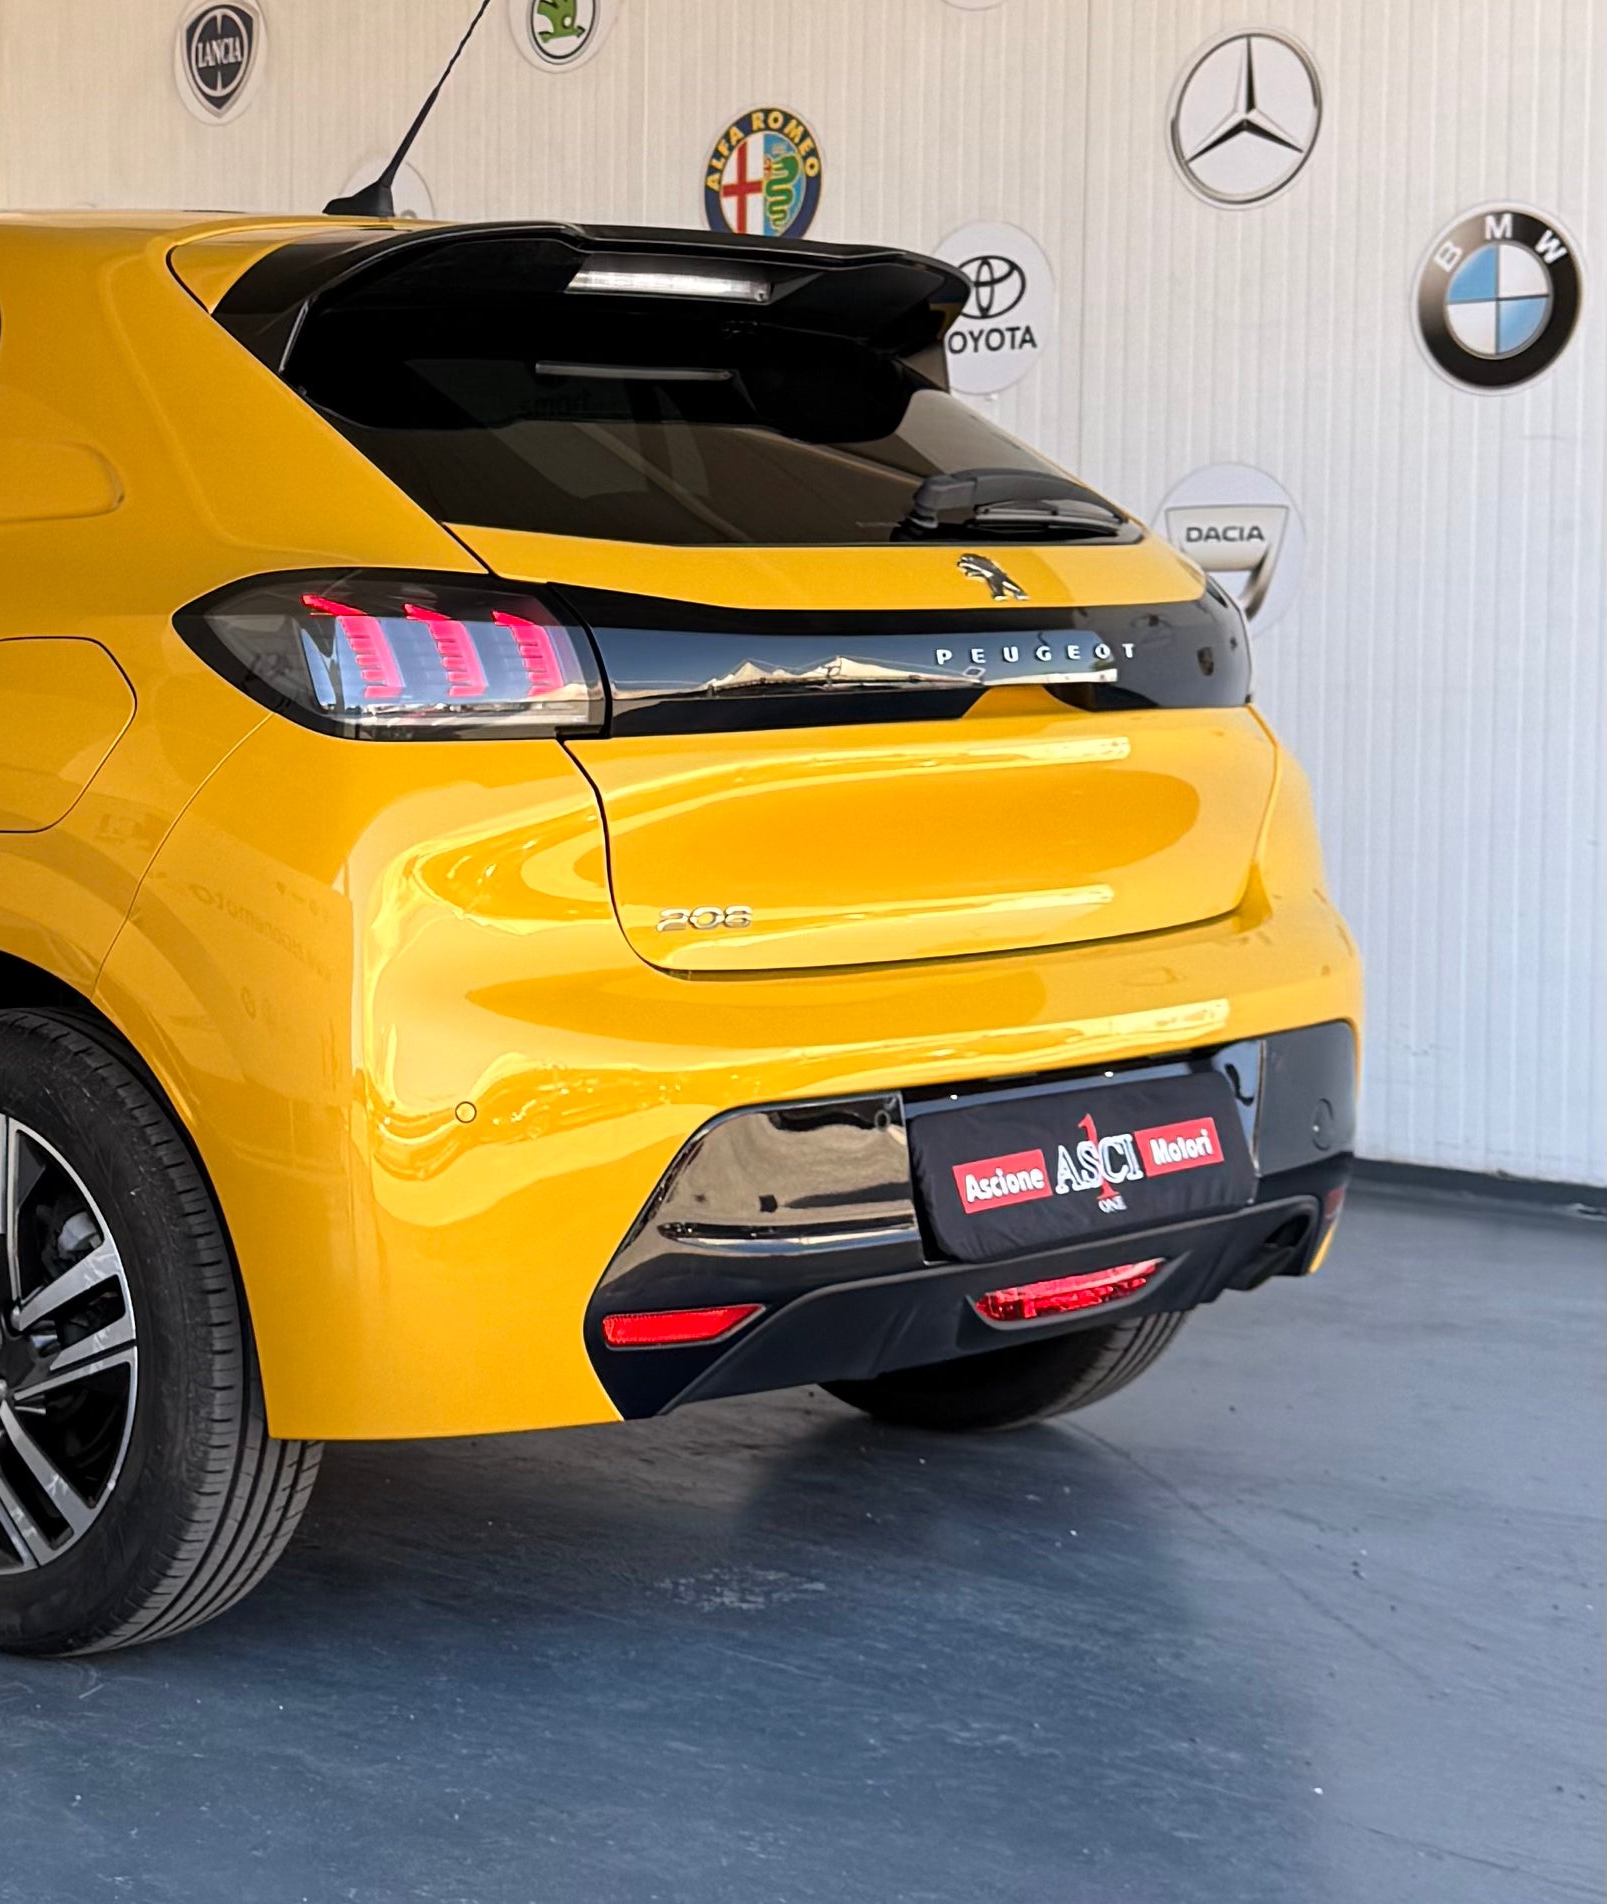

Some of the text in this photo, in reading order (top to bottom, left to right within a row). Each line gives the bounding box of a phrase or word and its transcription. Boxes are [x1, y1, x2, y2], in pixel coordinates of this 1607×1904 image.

[197, 36, 243, 68] LANCIA
[706, 110, 820, 192] ALFA ROMEO
[1433, 213, 1568, 273] BMW
[948, 325, 1037, 354] OYOTA
[1186, 525, 1266, 543] DACIA
[935, 643, 1135, 665] PEUGEOT
[656, 905, 753, 932] 208
[965, 1128, 1213, 1203] Ascione ASCI Motori
[1097, 1195, 1128, 1213] ONE
